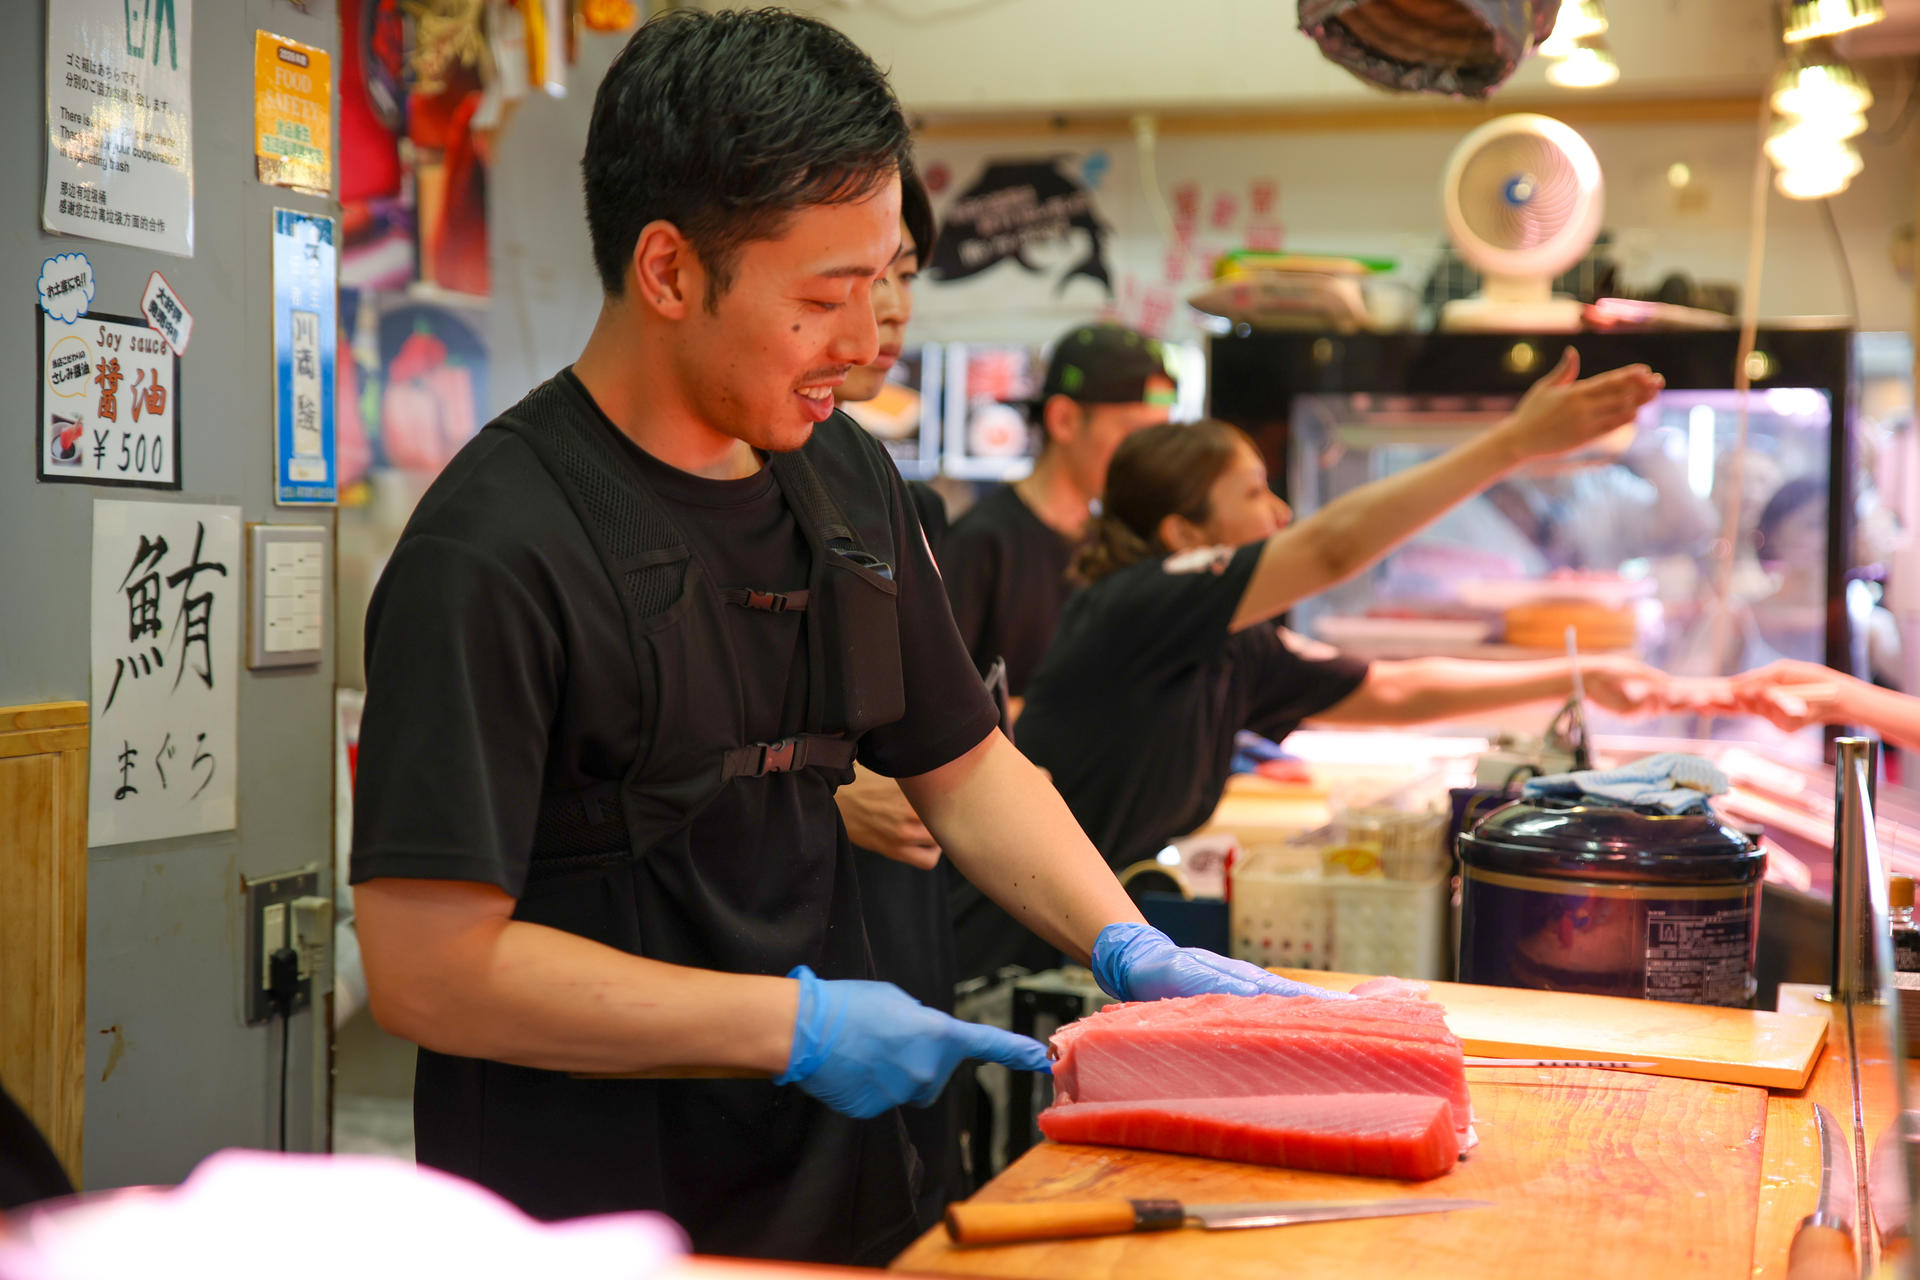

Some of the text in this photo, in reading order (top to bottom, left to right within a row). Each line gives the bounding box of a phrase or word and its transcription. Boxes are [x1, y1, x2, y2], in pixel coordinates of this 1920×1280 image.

[275, 66, 312, 94] FOOD
[60, 106, 82, 124] There
[264, 88, 320, 121] SAFETY
[96, 325, 168, 356] Soy sauce
[95, 356, 167, 423] 醤油
[102, 521, 227, 717] 鮪
[114, 732, 215, 801] まぐろ
